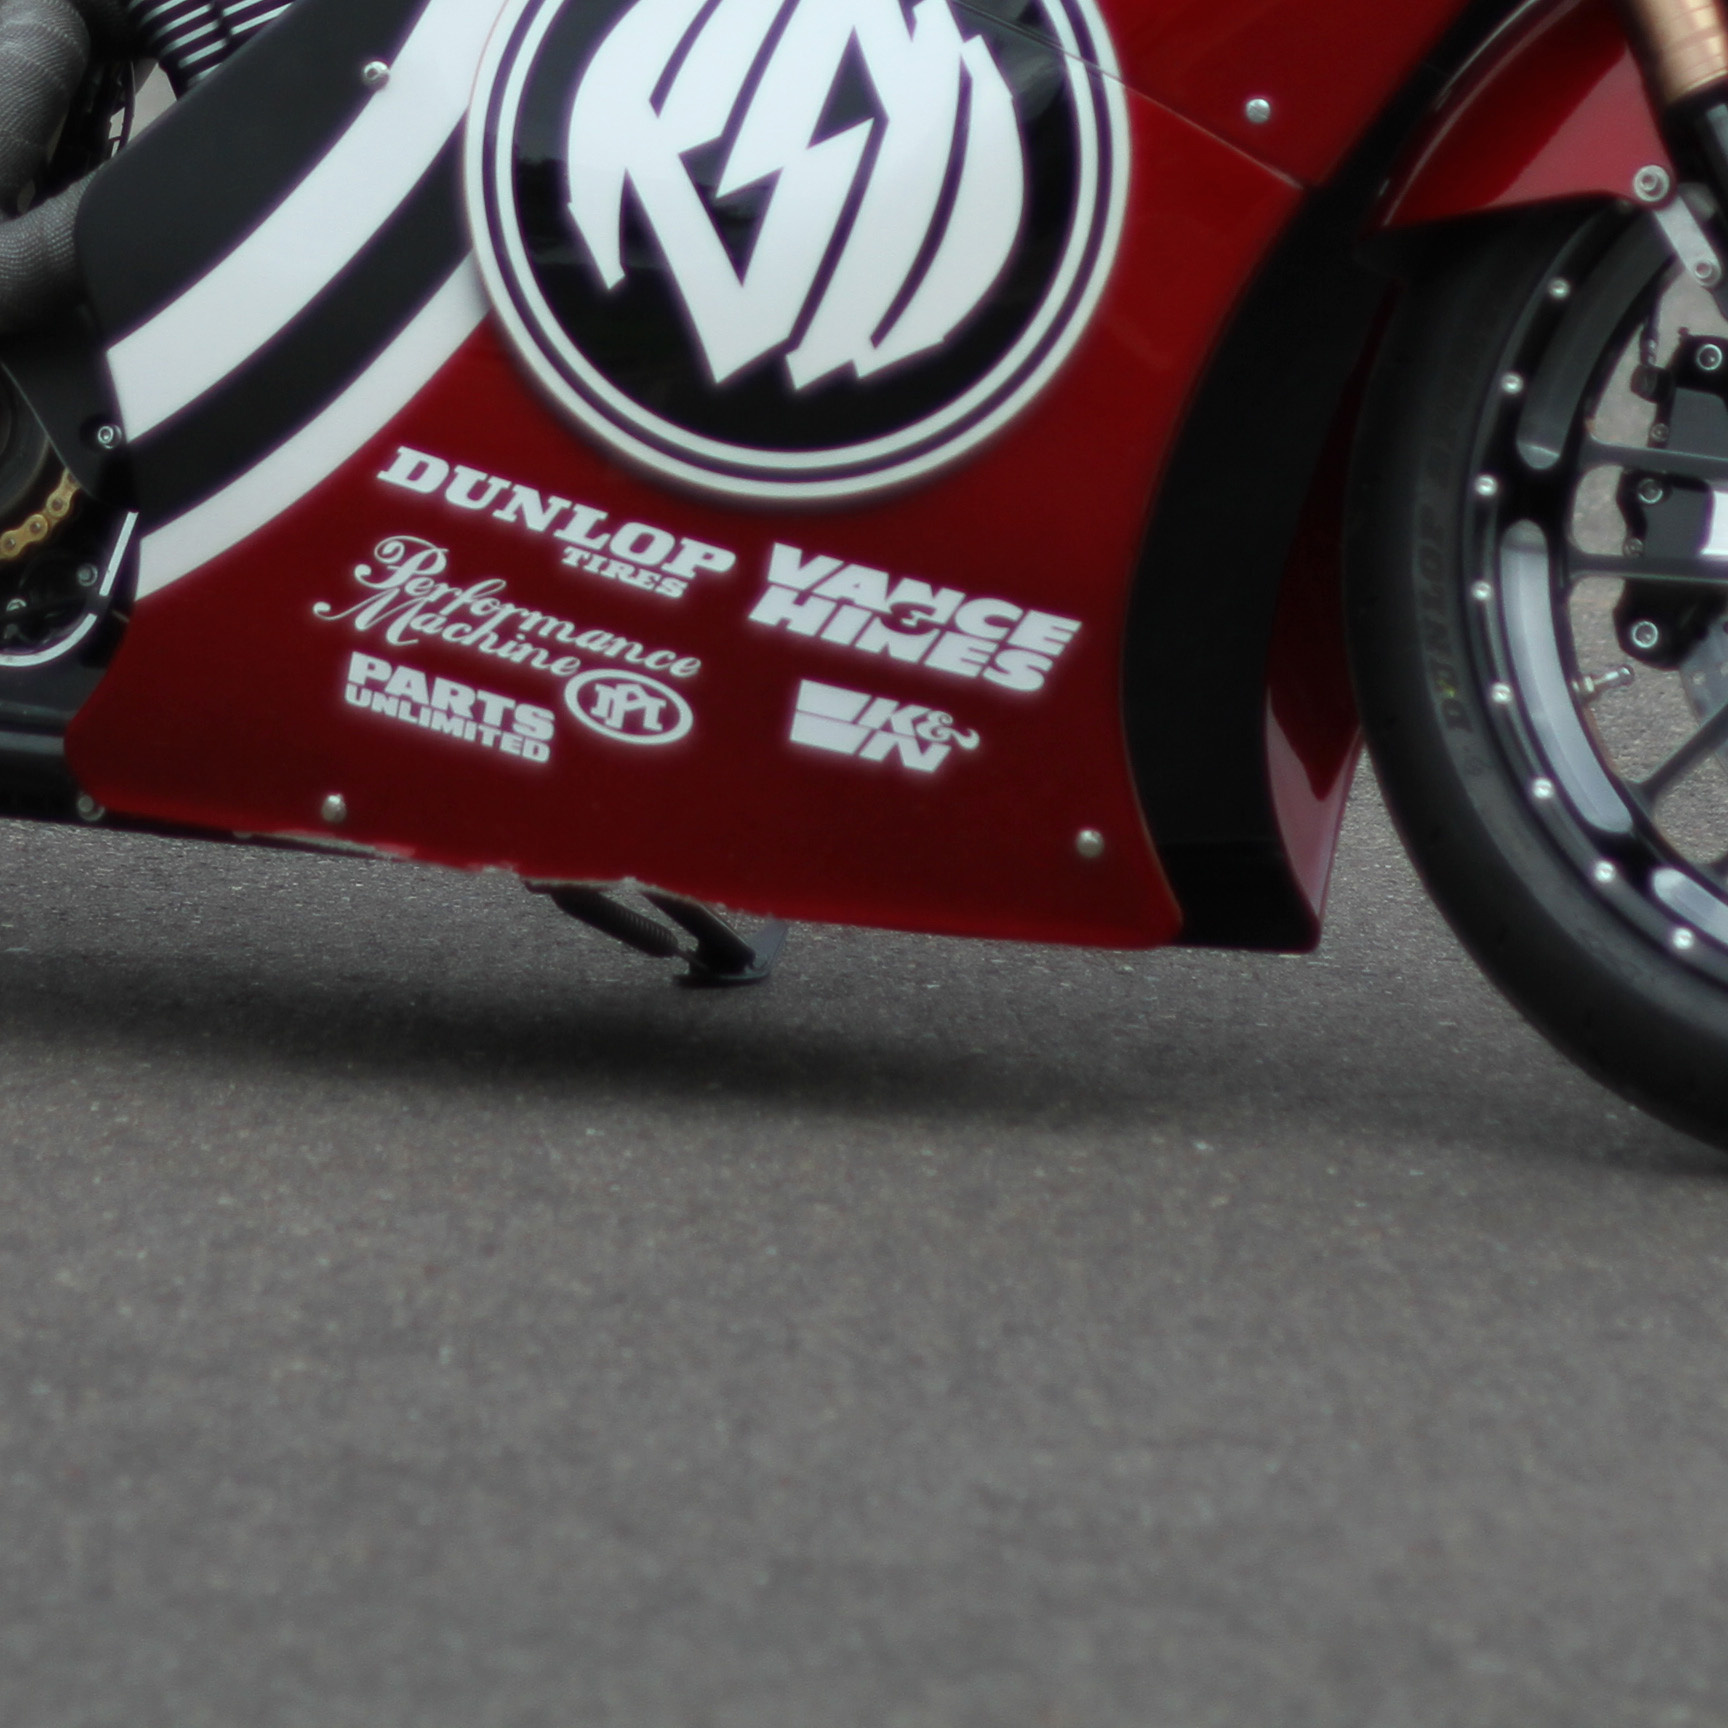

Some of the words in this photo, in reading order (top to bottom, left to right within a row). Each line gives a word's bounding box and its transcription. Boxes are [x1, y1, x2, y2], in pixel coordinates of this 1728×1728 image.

[376, 446, 736, 578] DUNLOP
[355, 535, 701, 677] Performance
[561, 546, 688, 598] TIRES
[770, 543, 1083, 656] VANCE
[312, 587, 581, 678] Machine
[748, 583, 1055, 692] HINES
[345, 683, 551, 763] UNLIMITED
[348, 652, 555, 741] PARTS
